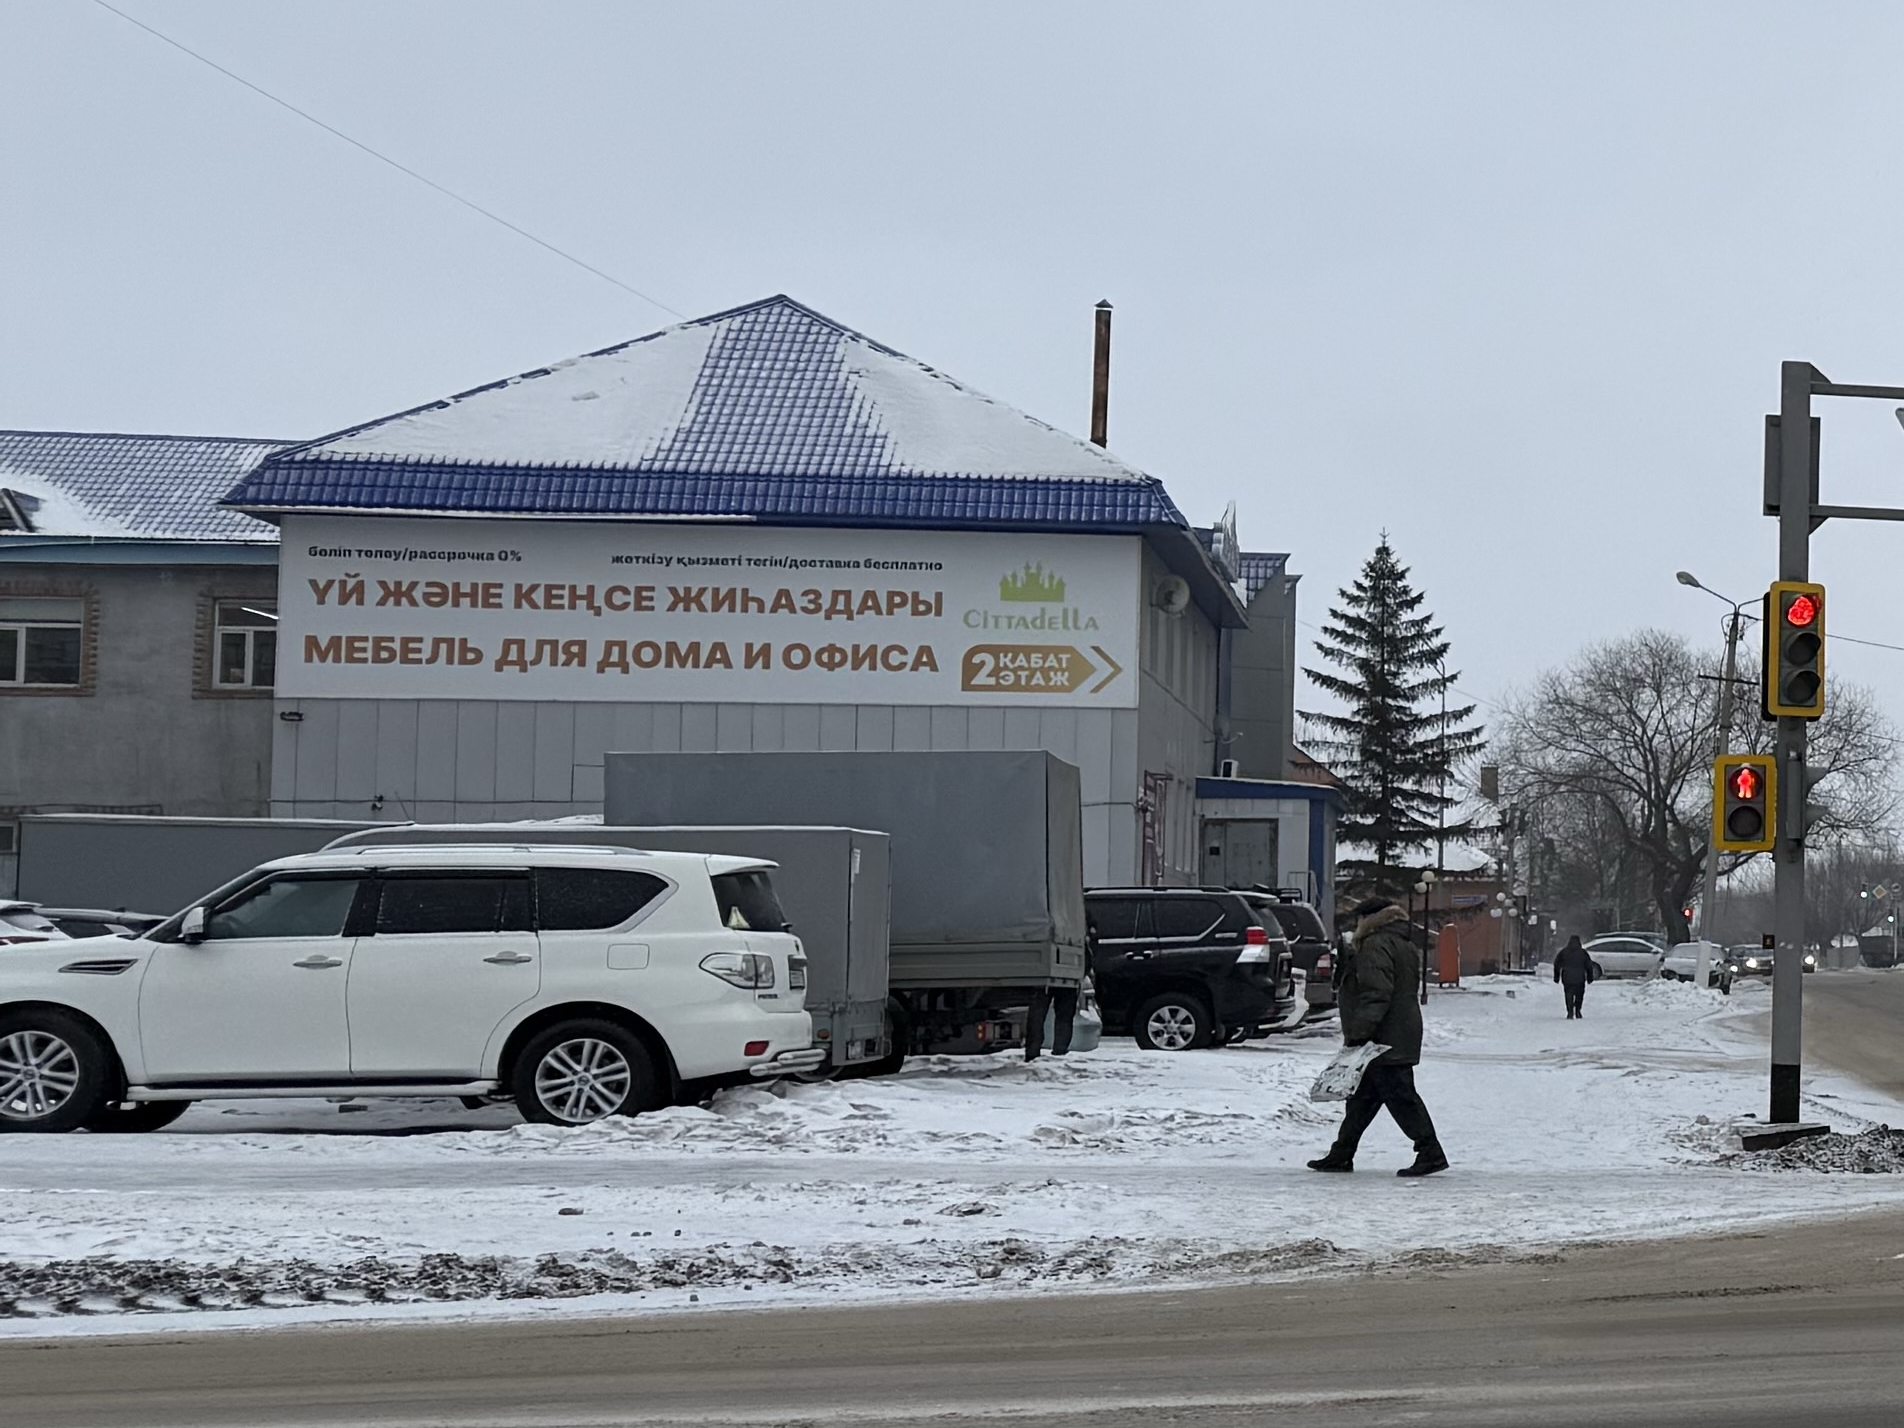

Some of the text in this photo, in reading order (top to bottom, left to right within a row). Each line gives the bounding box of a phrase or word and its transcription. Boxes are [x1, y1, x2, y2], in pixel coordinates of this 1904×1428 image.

[497, 549, 522, 562] 0%
[307, 572, 943, 622] ҮЙ ЖӘНЕ КЕҢСЕ ЖИҺАЗДАРЫ
[303, 634, 940, 675] МЕБЕЛЬ ДЛЯ ДОМА И ОФИСА
[970, 652, 997, 686] 2
[999, 670, 1070, 687] ЭТАЖ
